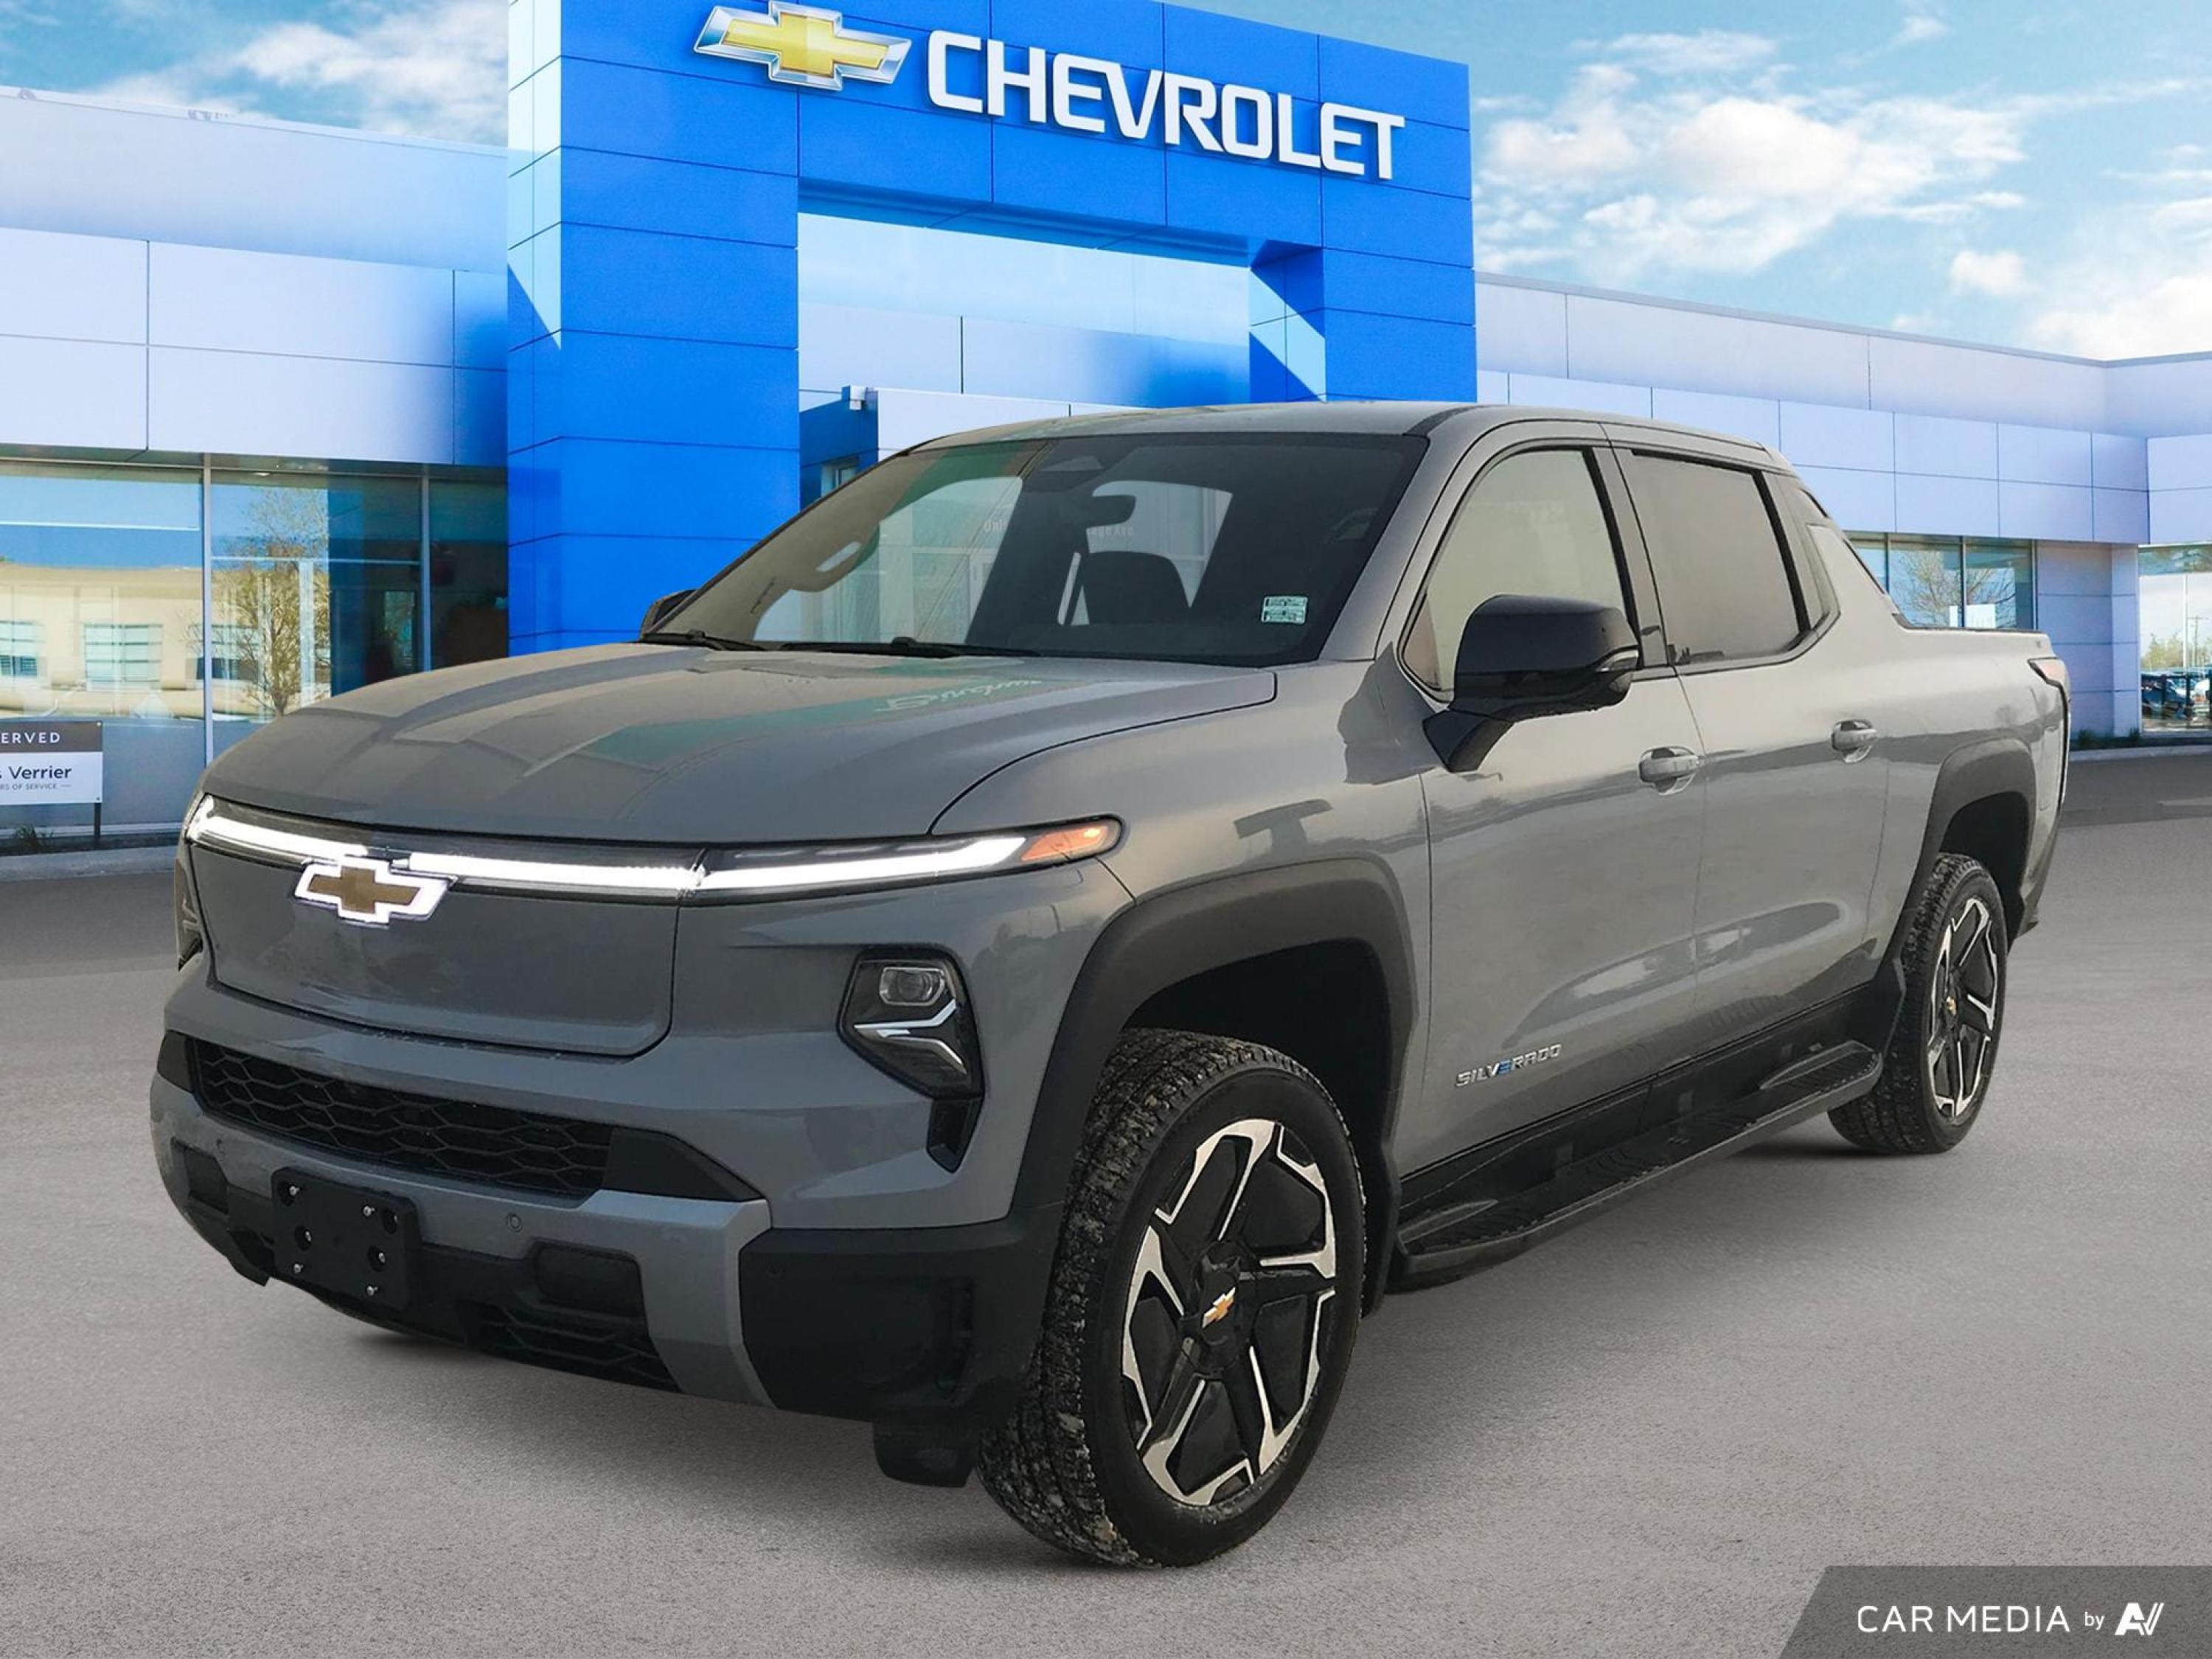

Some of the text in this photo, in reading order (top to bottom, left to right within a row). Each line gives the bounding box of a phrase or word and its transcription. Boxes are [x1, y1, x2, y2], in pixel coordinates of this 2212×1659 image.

[928, 29, 1405, 180] CHEVROLET
[8, 765, 72, 779] Verrier
[25, 782, 58, 790] SERVICE
[1455, 1043, 1562, 1088] SILVERADO
